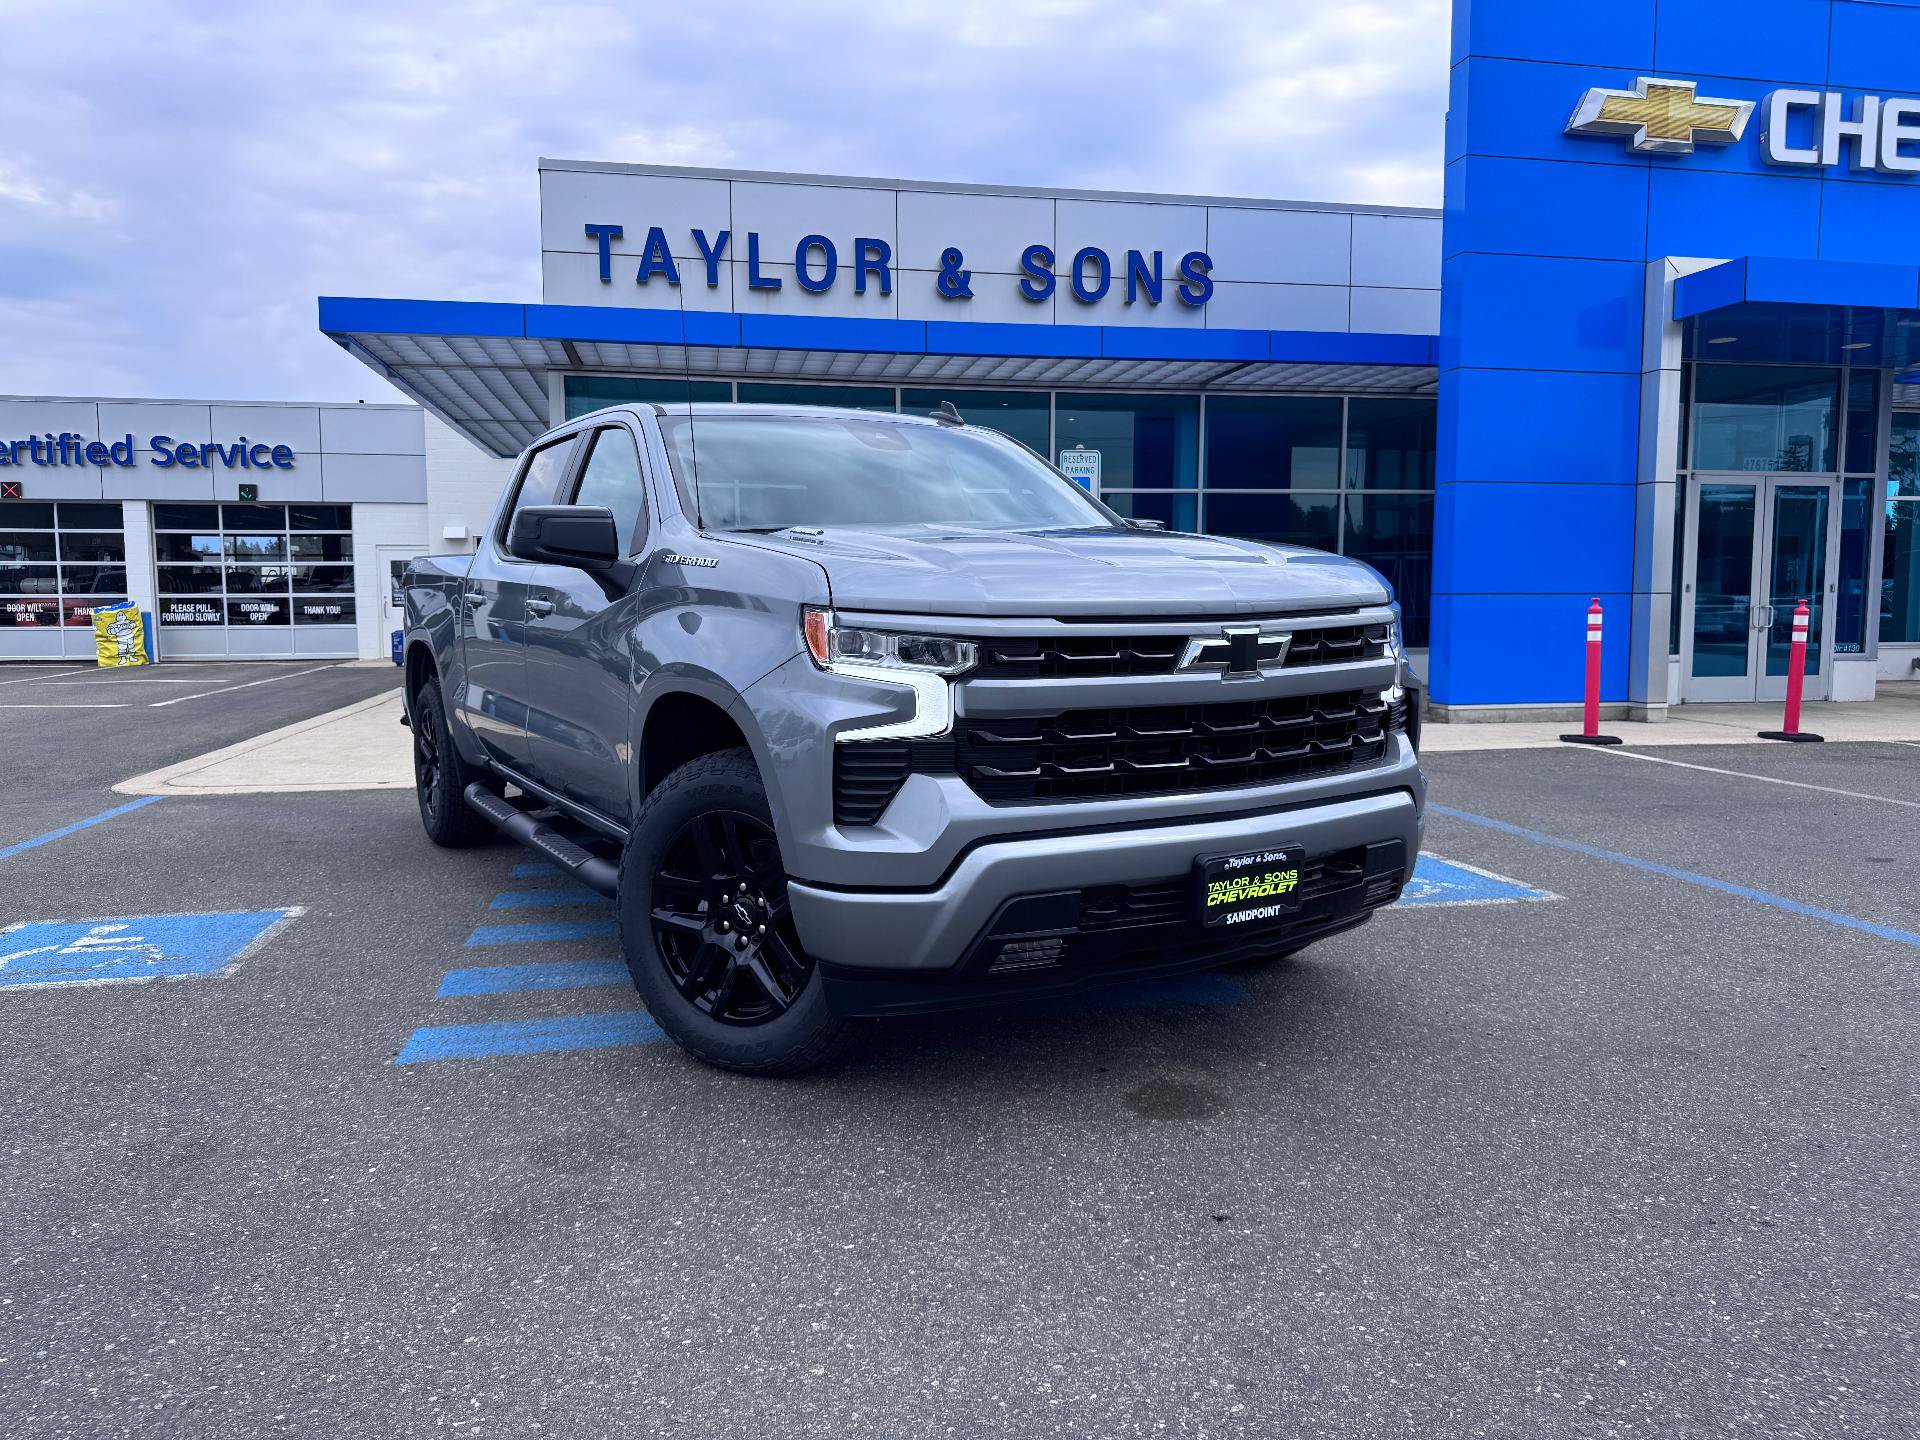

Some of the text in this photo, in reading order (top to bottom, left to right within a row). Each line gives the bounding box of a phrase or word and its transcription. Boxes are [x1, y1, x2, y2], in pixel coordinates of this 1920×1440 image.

[1761, 88, 1920, 170] CHE
[585, 223, 1214, 306] TAYLOR & SONS
[150, 435, 293, 468] Service
[1063, 455, 1096, 464] RESERVED
[1065, 466, 1095, 474] PARKING
[7, 603, 43, 613] DOOR WILL
[171, 603, 211, 612] PLEASE PULL
[241, 603, 274, 612] DOOR WILL
[304, 606, 341, 614] THANK YOU!
[17, 613, 35, 621] OPEN
[162, 612, 220, 621] FORWARD SLOWLY
[250, 612, 267, 621] OPEN
[1229, 852, 1284, 869] Taylor & Sons
[1208, 870, 1298, 892] TAYLOR & SONS
[1207, 881, 1298, 906] CHEVROLET
[1226, 905, 1281, 924] SANDPOINT
